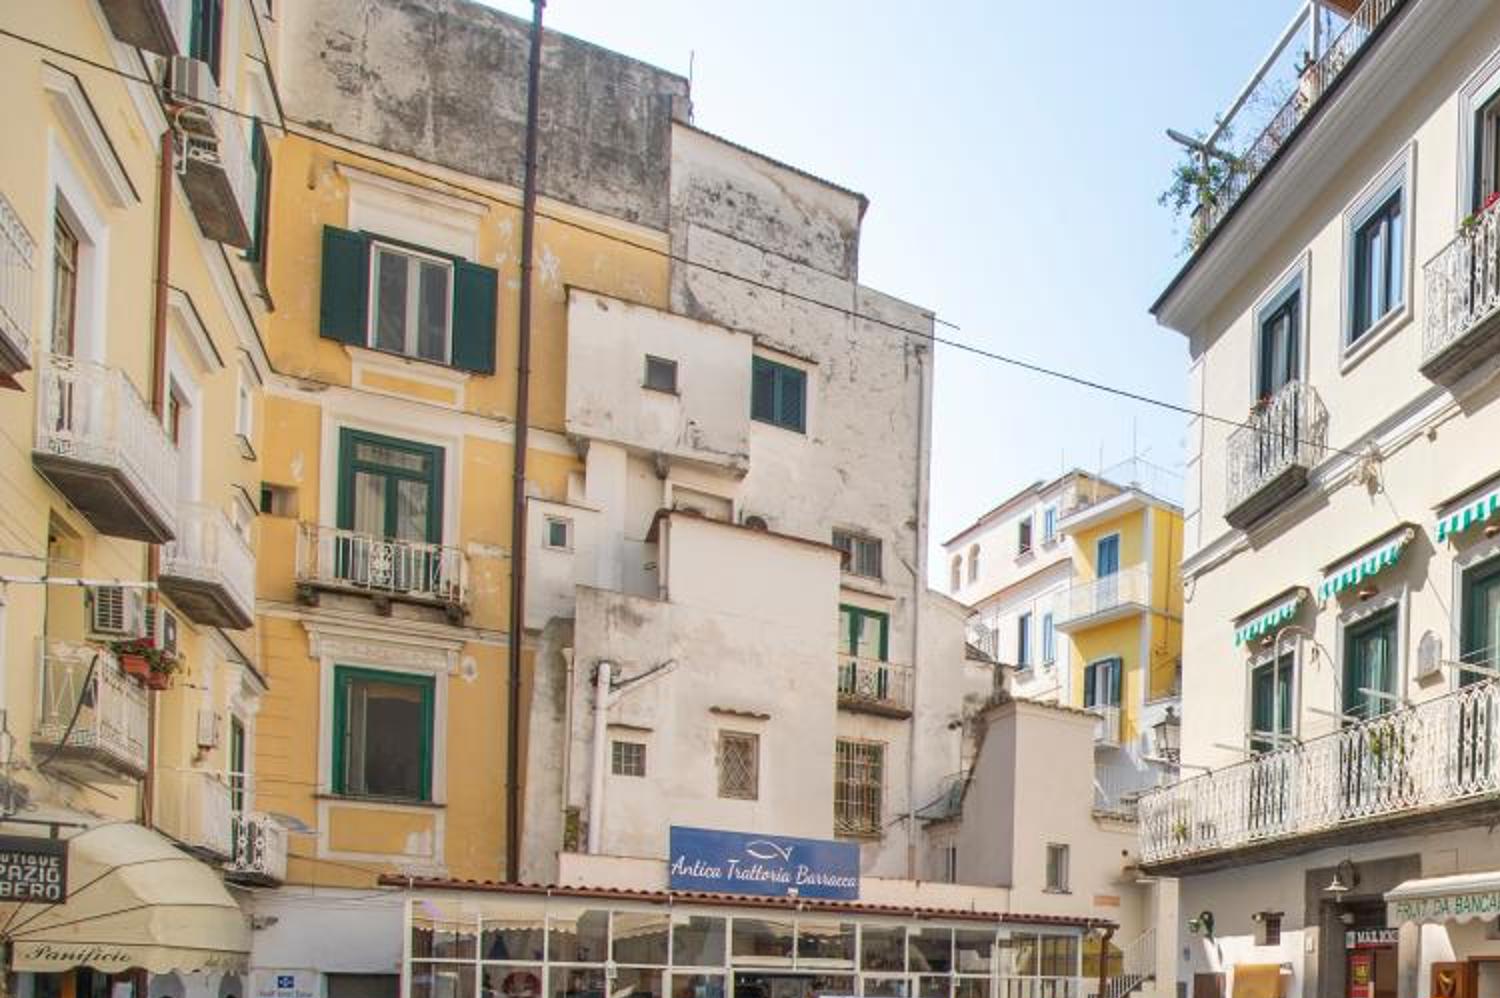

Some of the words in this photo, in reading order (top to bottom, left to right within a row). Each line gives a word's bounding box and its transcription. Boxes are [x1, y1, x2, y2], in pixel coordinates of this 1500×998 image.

[672, 856, 722, 880] Antica
[727, 859, 792, 884] Trattoria
[796, 864, 857, 888] Barracca
[25, 942, 132, 967] Panificio
